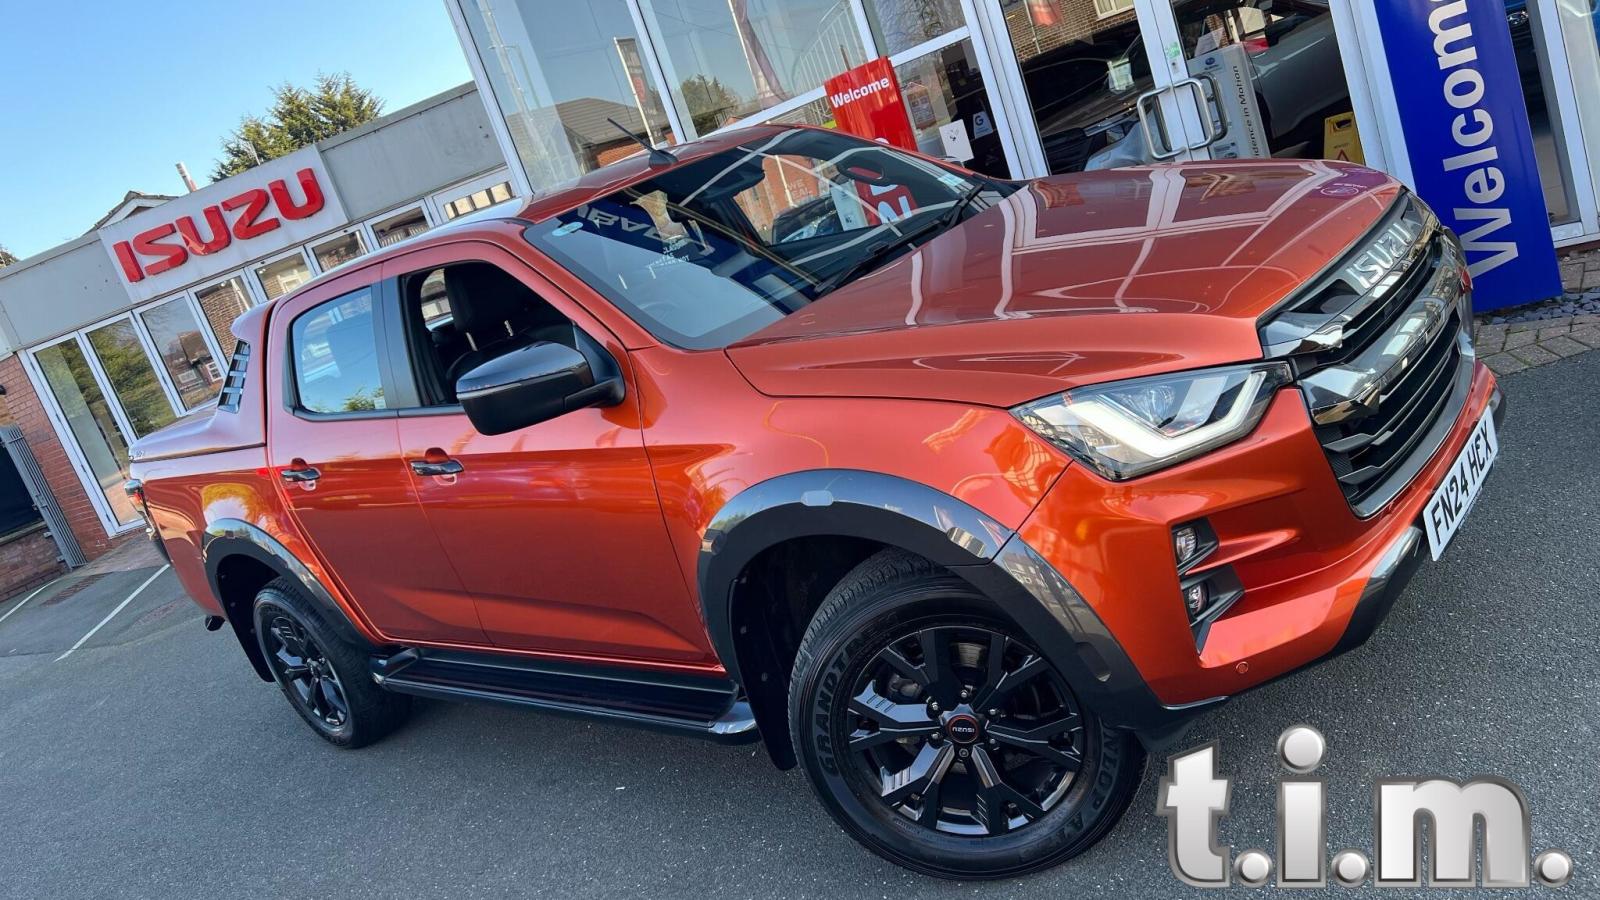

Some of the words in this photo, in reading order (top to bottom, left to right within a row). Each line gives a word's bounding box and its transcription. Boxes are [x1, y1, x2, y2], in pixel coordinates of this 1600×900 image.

[830, 77, 890, 108] Welcome
[1232, 65, 1248, 105] Motion
[1247, 120, 1260, 157] idence
[1428, 0, 1519, 280] Welcom
[112, 167, 325, 283] ISUZU
[1346, 222, 1413, 289] ISUZU
[1430, 461, 1470, 546] FN24
[1466, 419, 1492, 485] HEX
